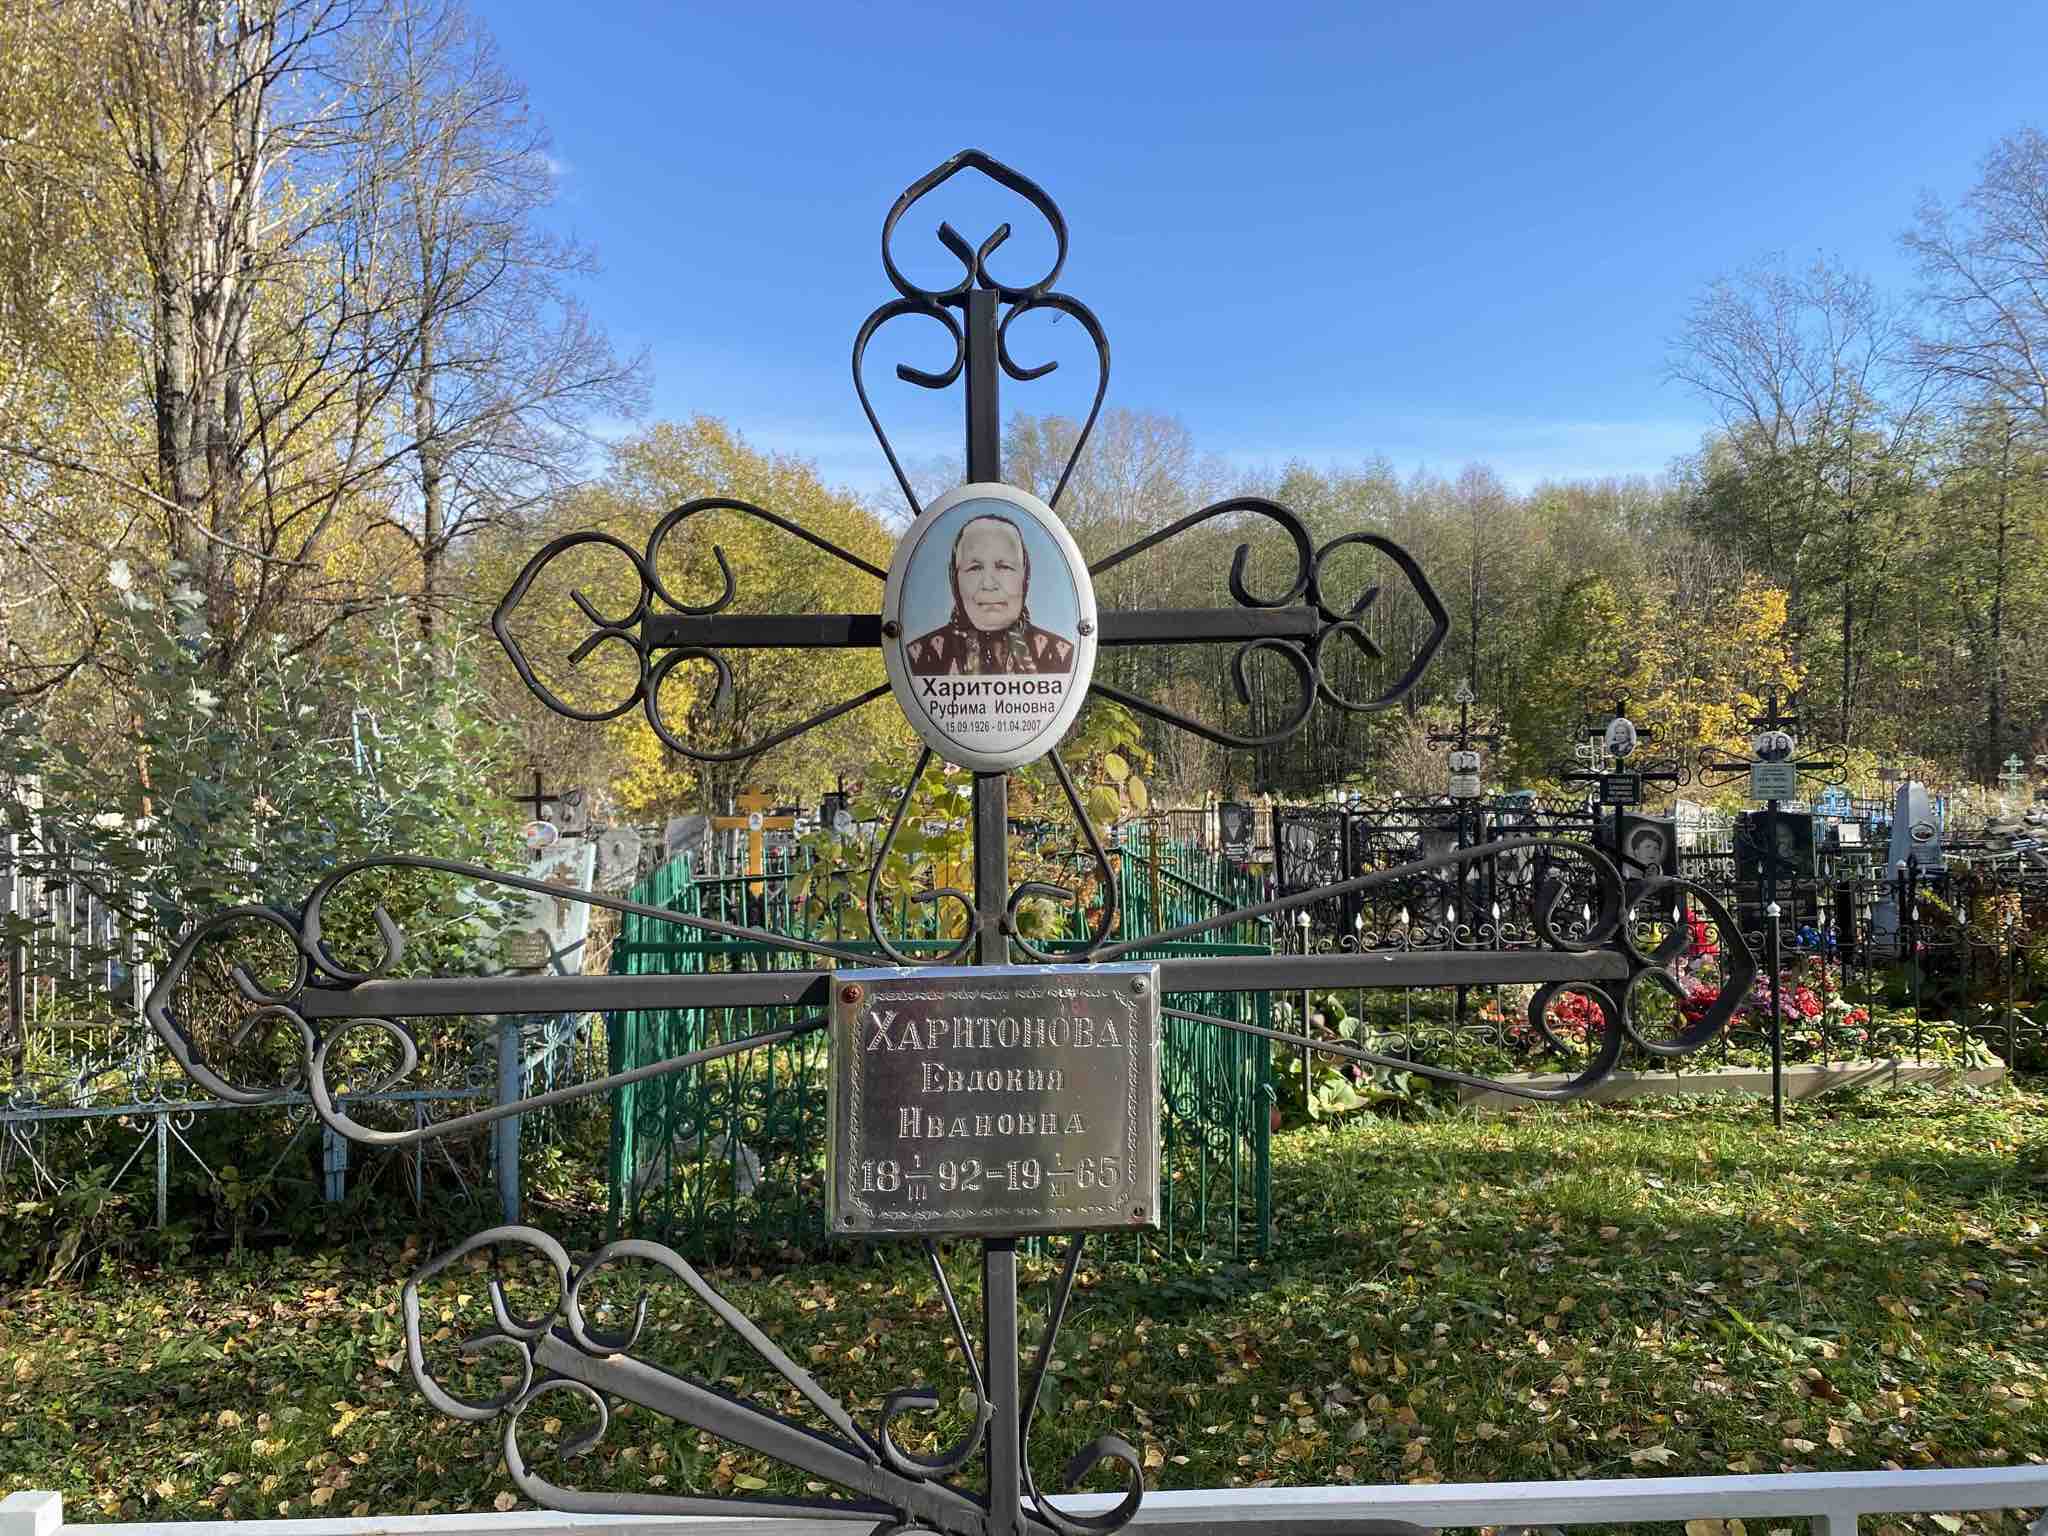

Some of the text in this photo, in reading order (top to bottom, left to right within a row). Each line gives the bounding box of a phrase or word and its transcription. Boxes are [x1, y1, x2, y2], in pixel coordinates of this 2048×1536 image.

[922, 677, 1063, 700] Харитонова
[929, 700, 1056, 719] Руфима Ионовна
[997, 719, 1042, 733] 01.04.2007
